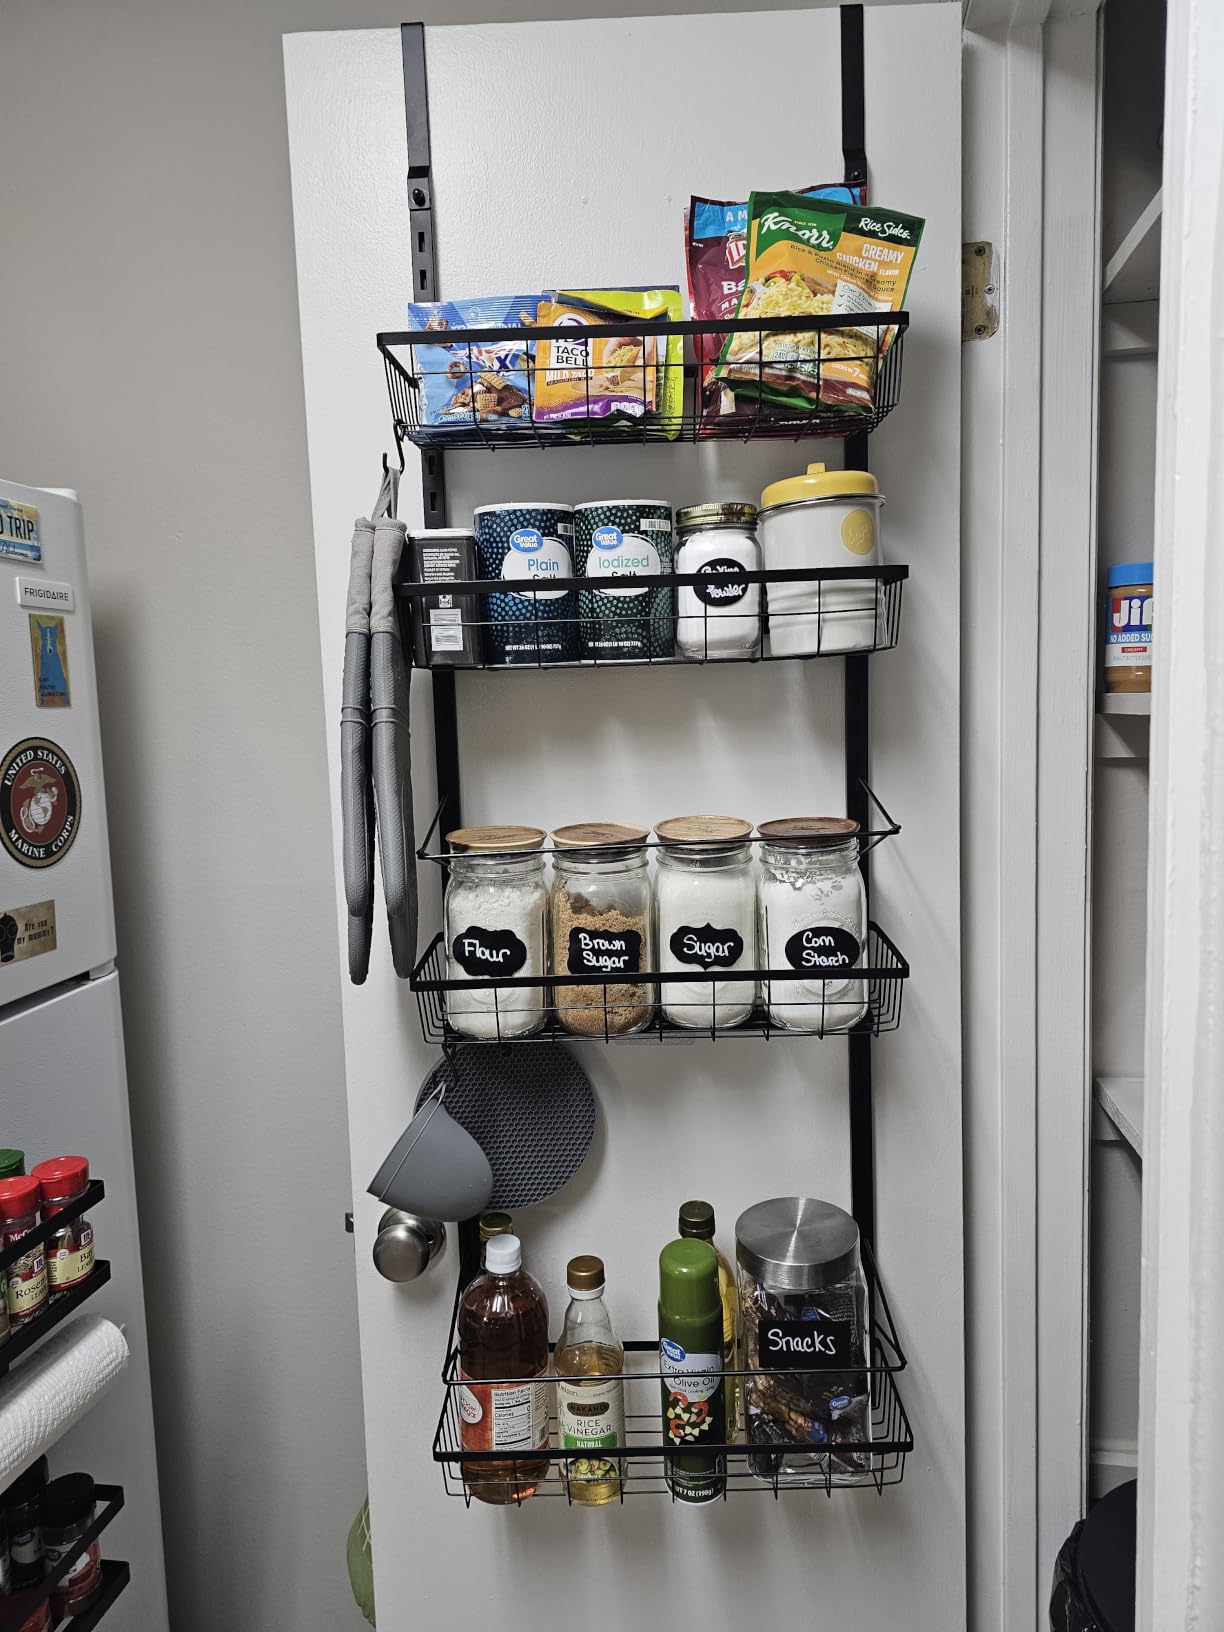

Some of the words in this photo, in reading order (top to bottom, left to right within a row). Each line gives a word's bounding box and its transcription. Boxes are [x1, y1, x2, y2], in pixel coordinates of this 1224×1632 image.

[760, 211, 834, 249] Knorr
[858, 217, 882, 232] Rice
[878, 221, 909, 239] Sides
[790, 244, 806, 253] Rice
[861, 243, 905, 264] CREAMY
[836, 252, 879, 273] CHICKEN
[555, 345, 590, 358] TACO
[556, 354, 589, 367] BELL
[7, 515, 34, 541] TRIP
[513, 534, 538, 544] Great
[596, 531, 618, 541] Great
[527, 558, 559, 571] Plain
[599, 555, 649, 568] Iodized
[24, 587, 69, 601] FRIGIDAIRE
[706, 584, 746, 598] Powder
[1117, 633, 1140, 643] ADDED
[4, 750, 34, 786] UNITED
[37, 749, 67, 775] STATES
[8, 829, 46, 858] MARINE
[51, 815, 74, 852] CORPS
[578, 932, 626, 951] Brown
[683, 934, 734, 962] Sugar
[462, 938, 511, 963] Flour
[582, 950, 630, 972] Sugar
[801, 949, 849, 967] Starch
[767, 1328, 837, 1355] Snacks
[674, 1376, 700, 1388] Olive
[702, 1376, 715, 1386] Oil
[570, 1403, 608, 1413] NAKANO
[567, 1424, 613, 1436] VINEGAR
[576, 1419, 601, 1428] RICE
[576, 1440, 603, 1449] NATURAL
